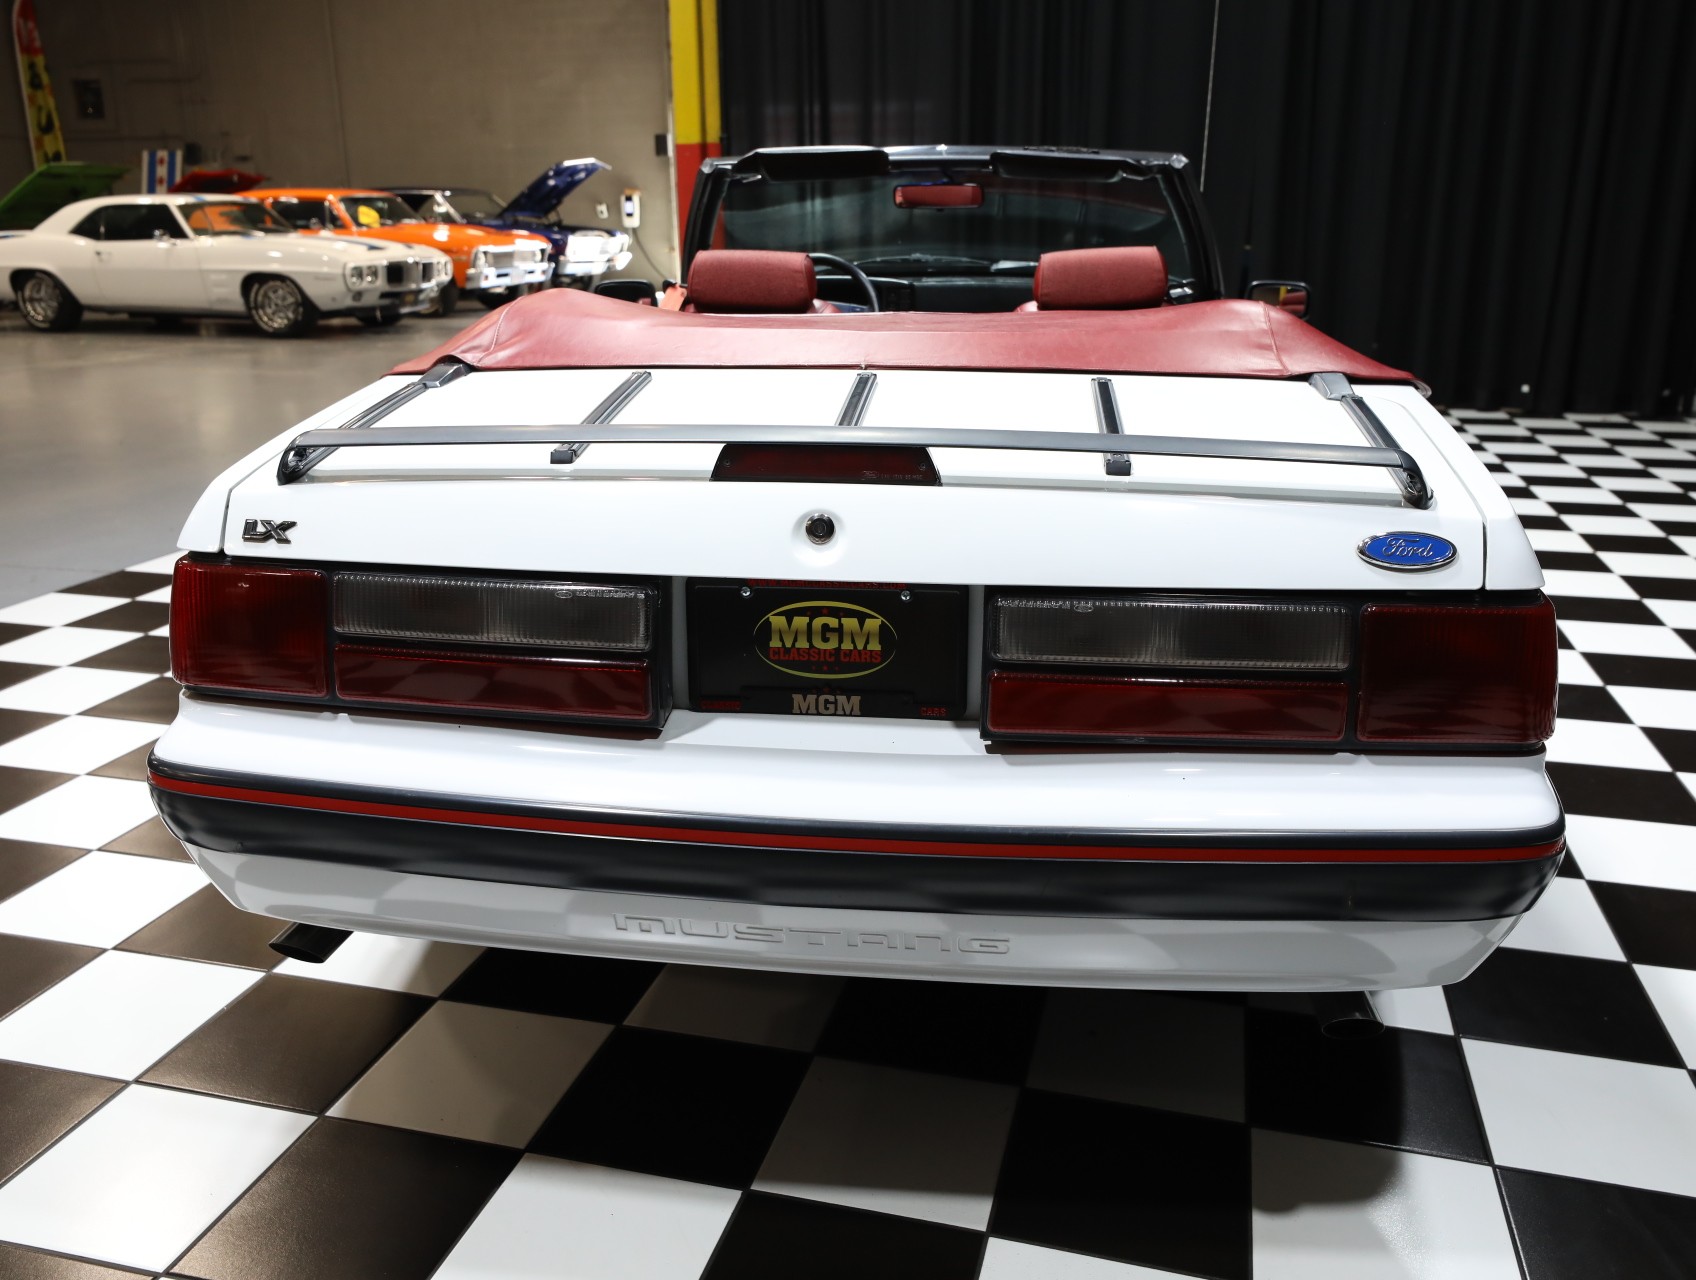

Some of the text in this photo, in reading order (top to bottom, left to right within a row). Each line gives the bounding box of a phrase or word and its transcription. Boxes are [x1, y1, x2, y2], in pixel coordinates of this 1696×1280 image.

[242, 519, 297, 544] LX
[1382, 537, 1434, 558] Ford
[769, 615, 882, 651] MGM
[769, 647, 882, 663] CLASSIC CARS
[792, 693, 862, 716] MGM
[612, 912, 1011, 955] MUSTANG
